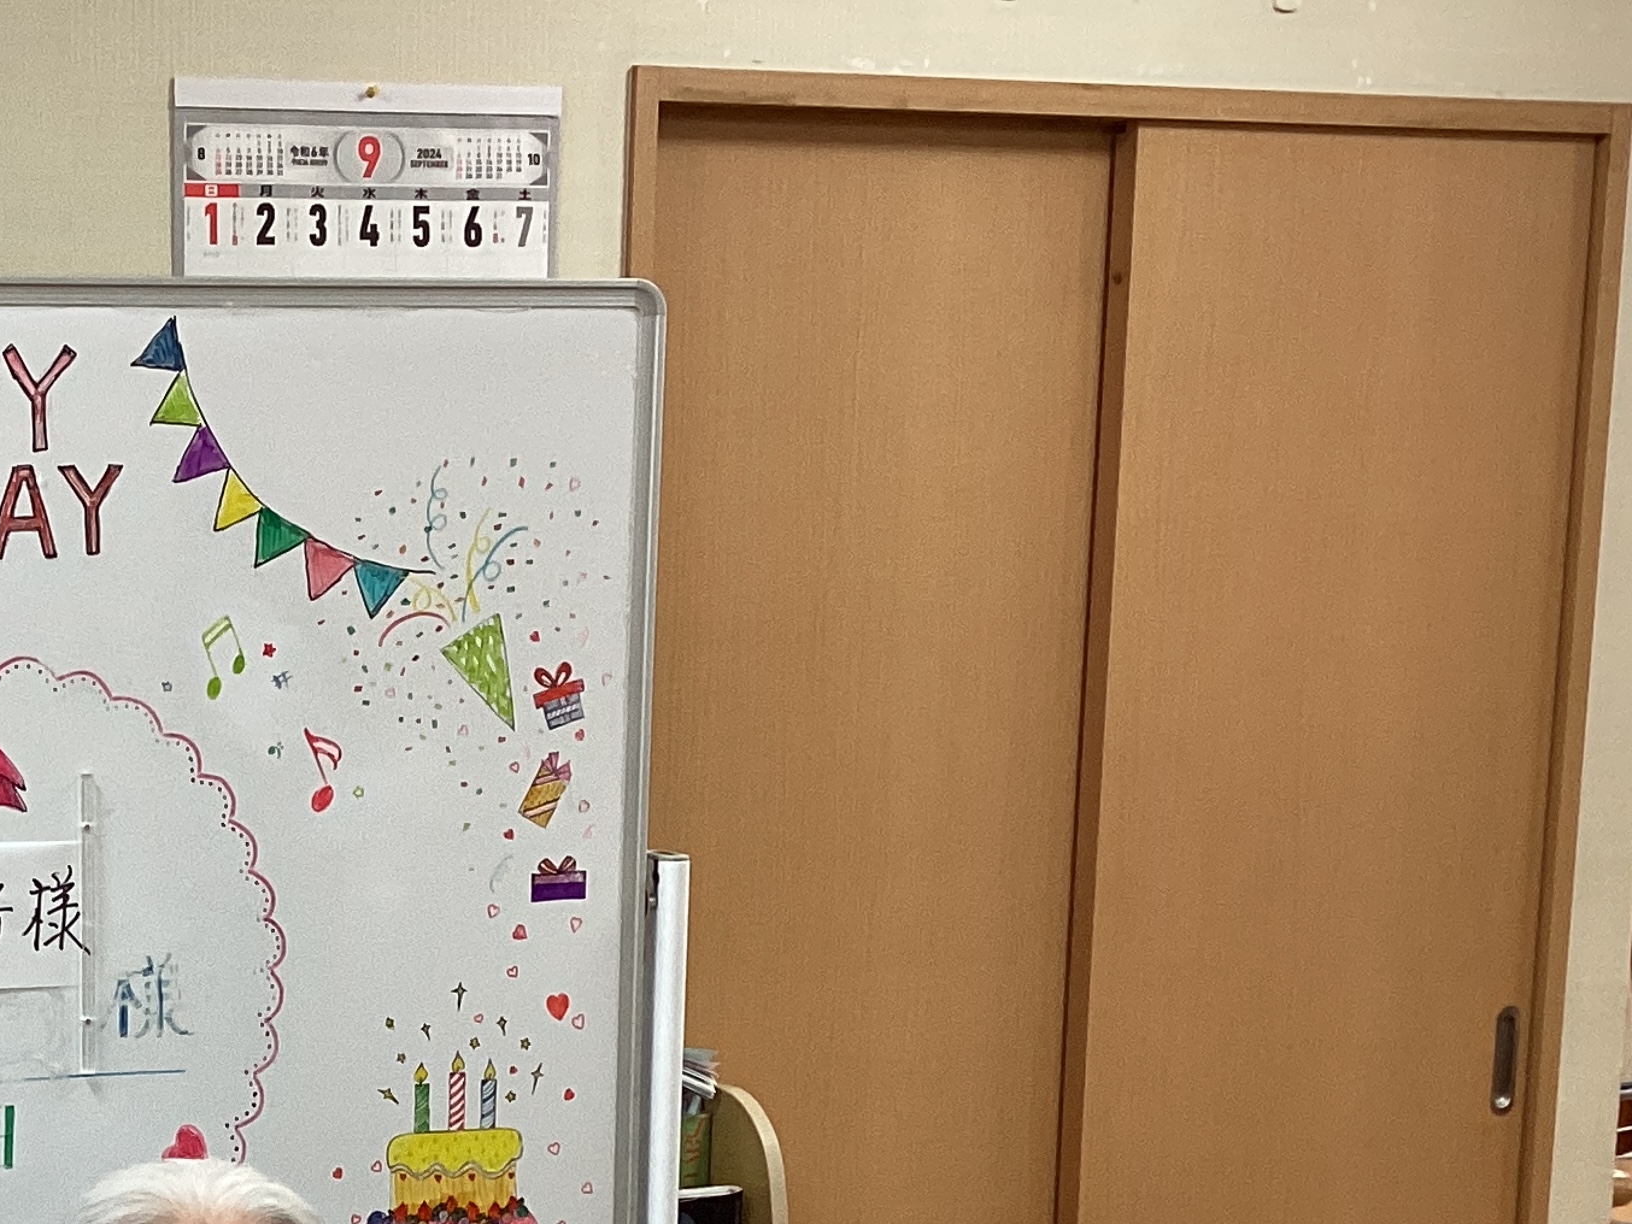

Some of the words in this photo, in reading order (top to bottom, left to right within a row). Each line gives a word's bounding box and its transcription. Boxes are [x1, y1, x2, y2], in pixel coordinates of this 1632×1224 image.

[197, 147, 206, 161] 8
[357, 135, 381, 178] 9
[417, 148, 442, 160] 2024
[527, 153, 541, 166] 10
[259, 185, 272, 198] 月
[310, 186, 324, 199] 火
[362, 187, 376, 199] 水
[414, 188, 428, 200] 木
[519, 189, 531, 201] 土
[204, 202, 218, 246] 1
[255, 202, 276, 246] 2
[308, 203, 328, 247] 3
[359, 205, 380, 247] 4
[412, 205, 431, 248] 5
[463, 205, 483, 248] 6
[515, 206, 534, 248] 7
